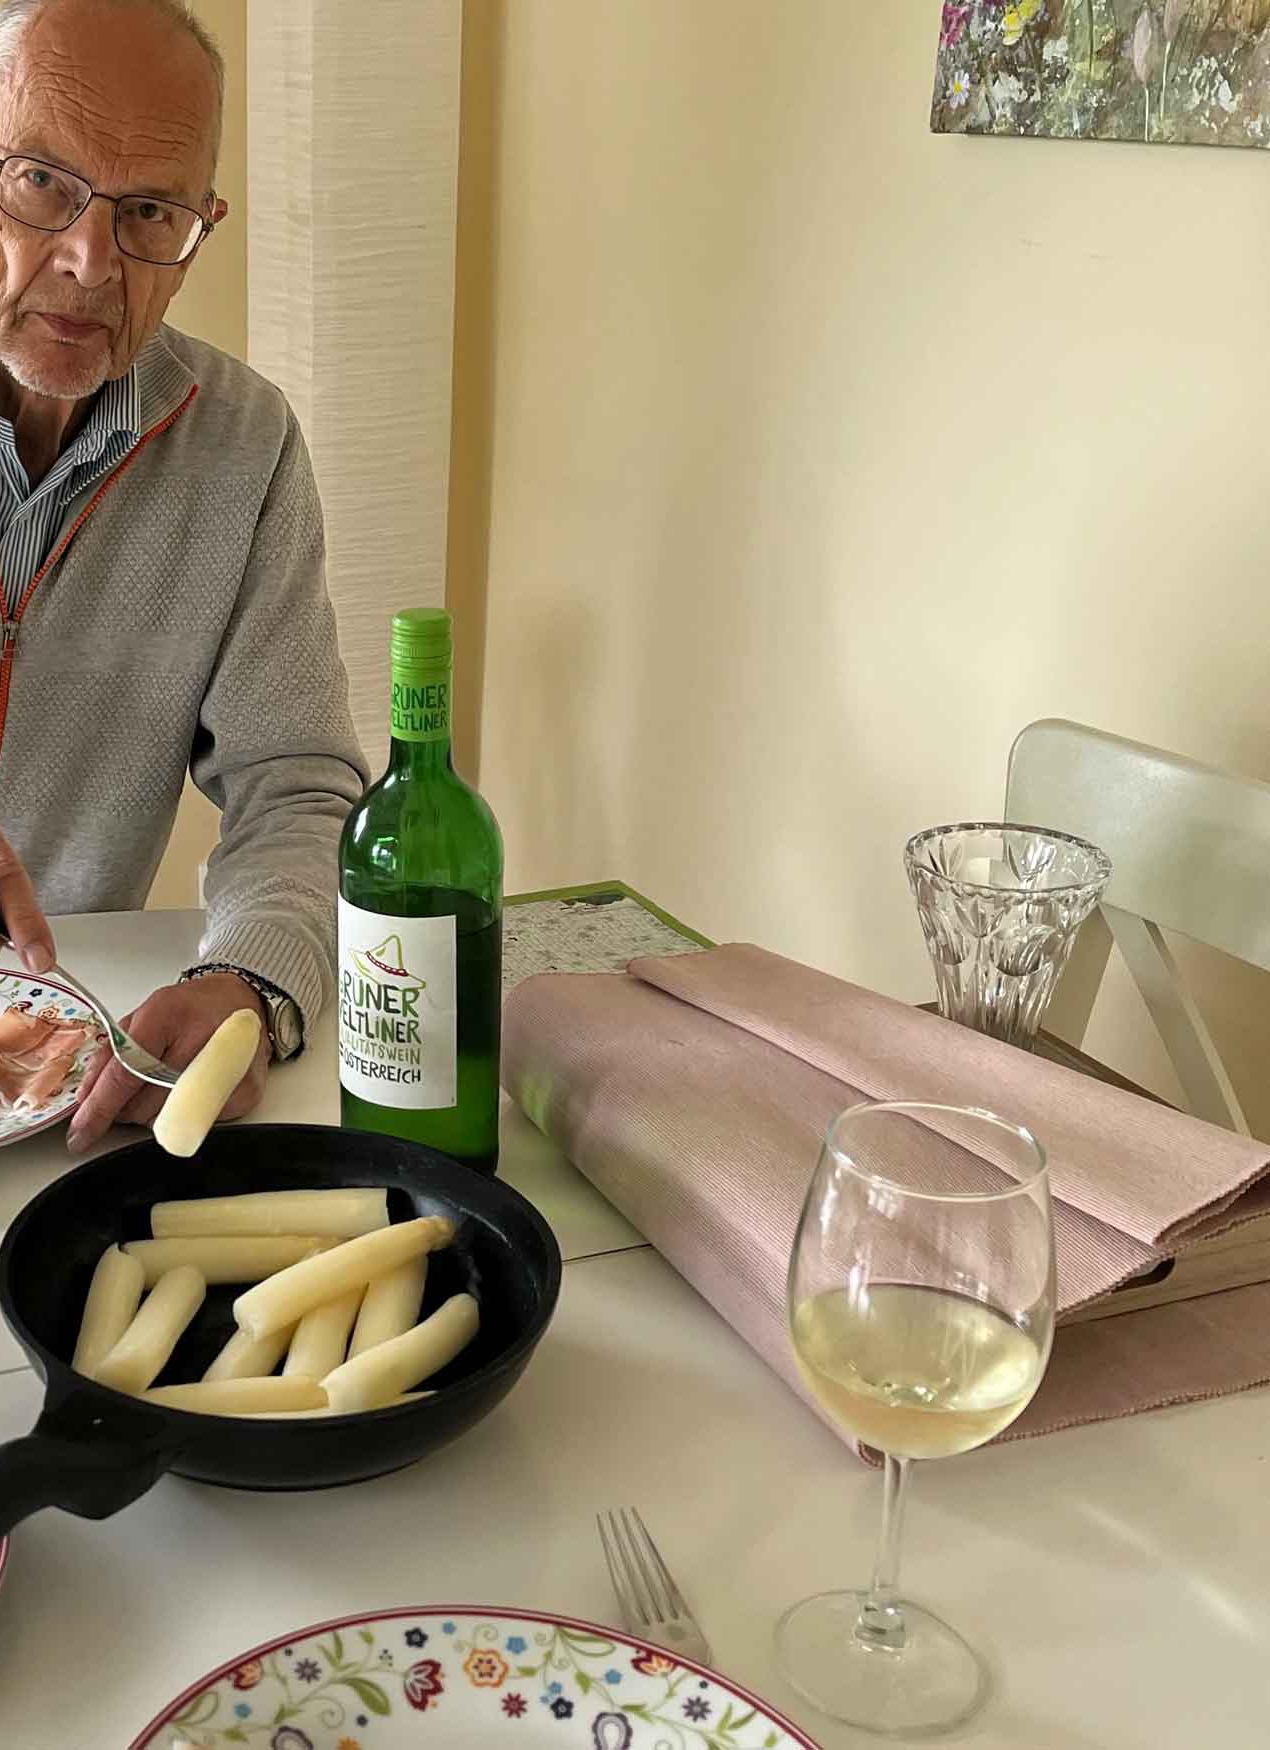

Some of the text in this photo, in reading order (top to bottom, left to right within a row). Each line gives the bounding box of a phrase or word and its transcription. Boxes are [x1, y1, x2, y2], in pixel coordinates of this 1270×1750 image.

[393, 682, 448, 711] RÜNER
[392, 707, 448, 732] ELTLINER
[341, 969, 421, 1018] RÜNER
